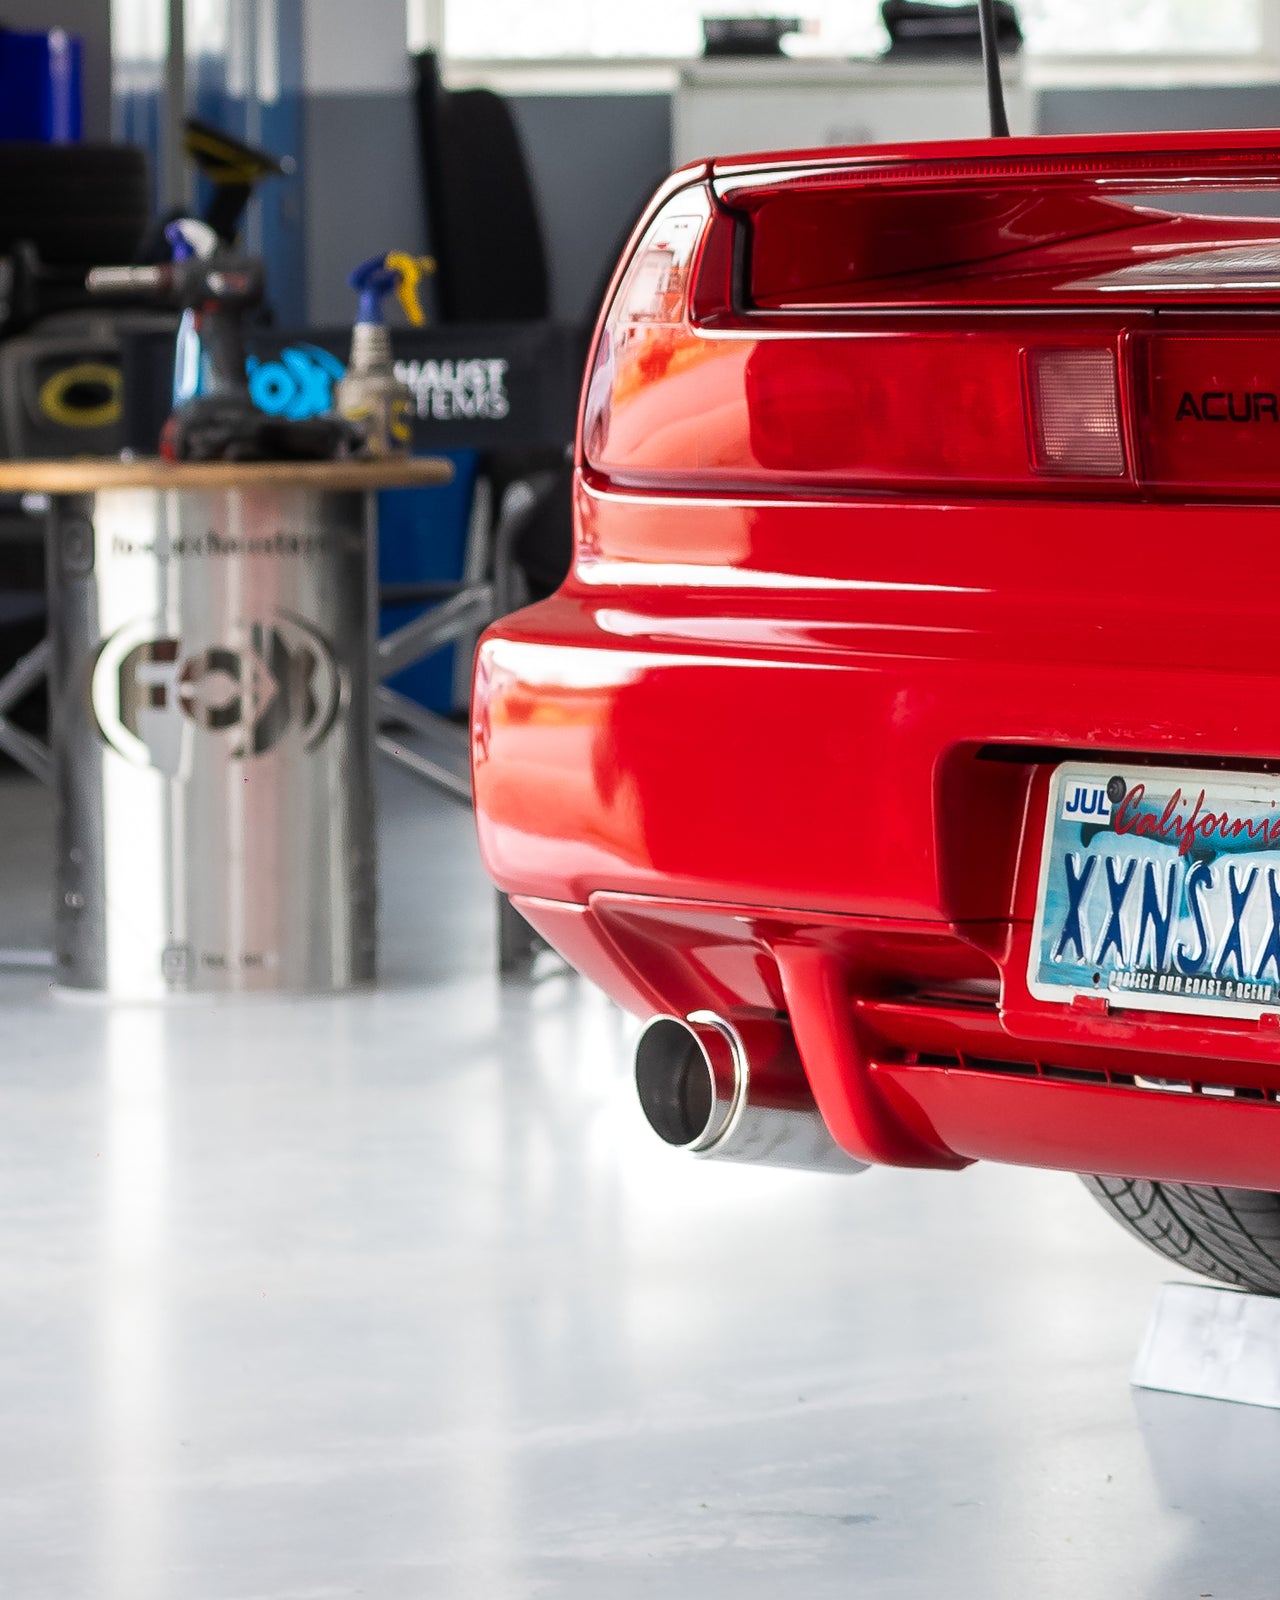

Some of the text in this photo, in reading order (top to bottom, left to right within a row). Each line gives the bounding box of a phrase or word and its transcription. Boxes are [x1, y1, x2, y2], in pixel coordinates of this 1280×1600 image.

[393, 359, 509, 390] HAUST
[1064, 786, 1111, 818] JUL
[1158, 975, 1182, 992] OUR
[1185, 977, 1222, 997] COAST
[1225, 981, 1234, 998] &
[1236, 982, 1272, 1002] OCEAN
